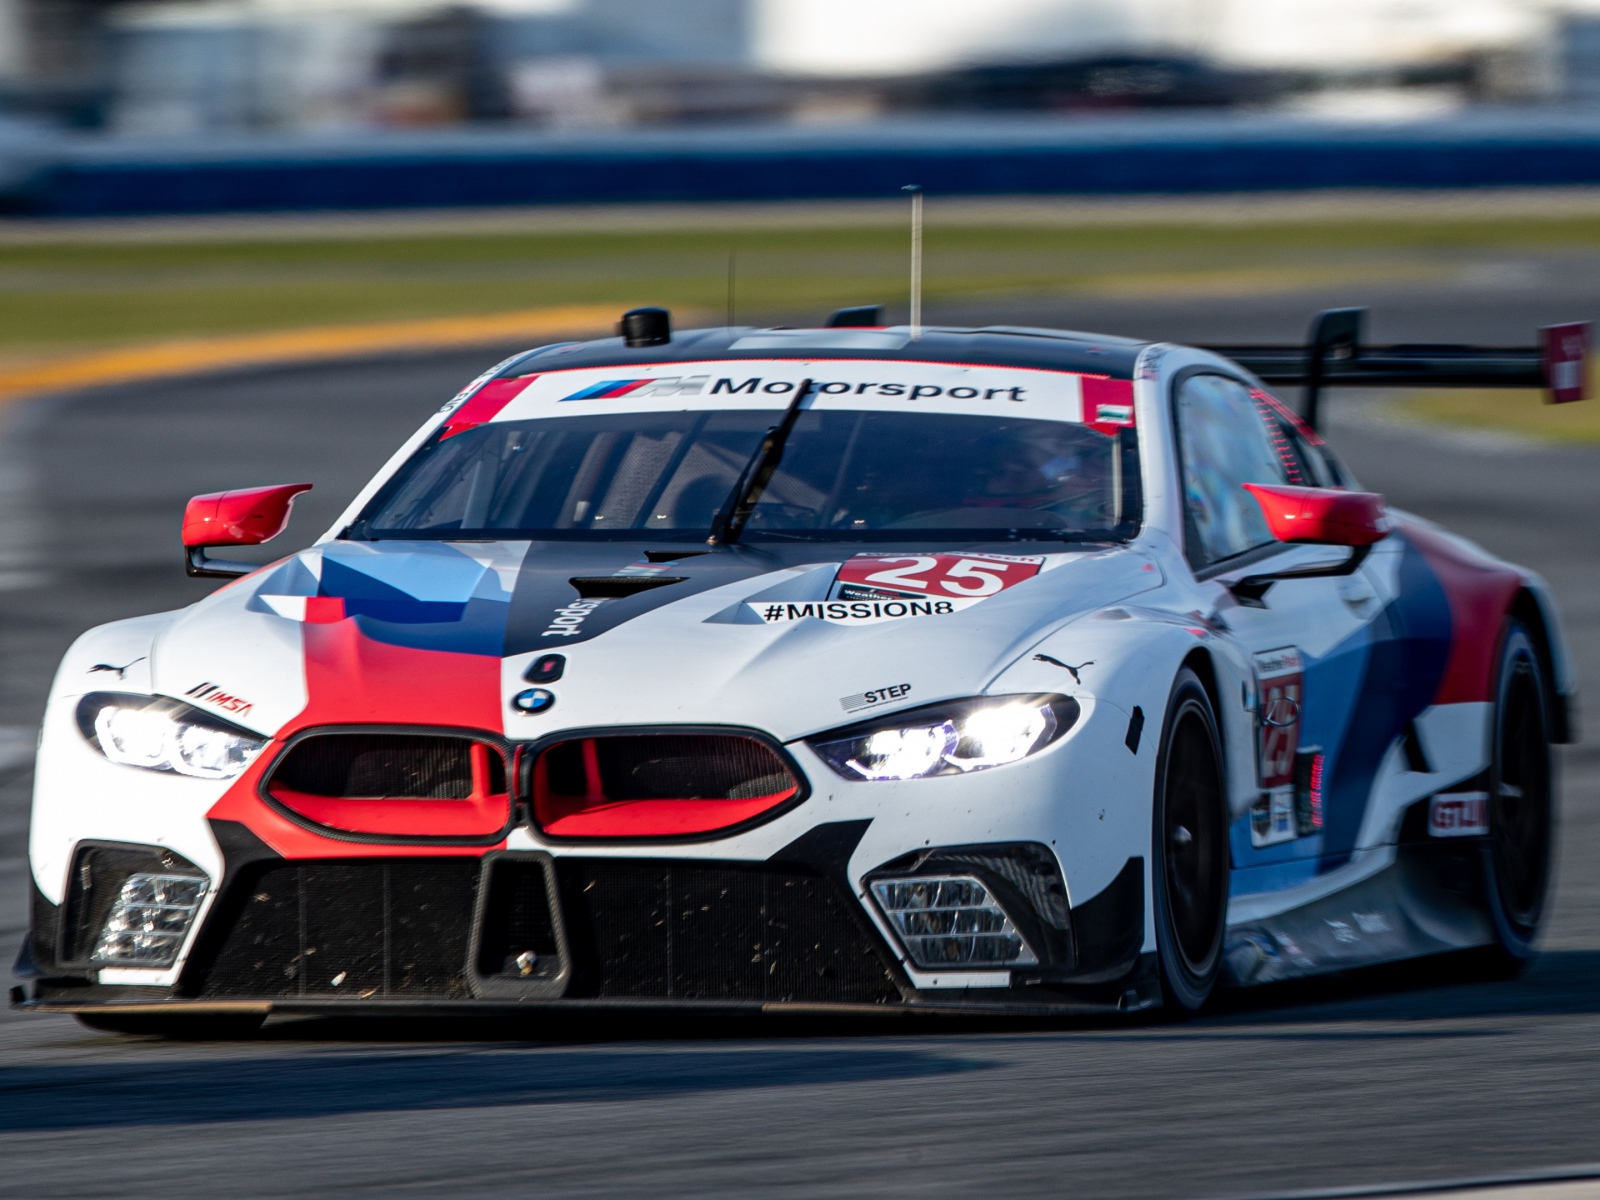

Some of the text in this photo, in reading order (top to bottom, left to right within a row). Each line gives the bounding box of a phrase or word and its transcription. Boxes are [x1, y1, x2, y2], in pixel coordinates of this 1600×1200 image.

[864, 556, 1005, 597] 25
[843, 589, 895, 601] Weather
[763, 600, 954, 621] #MISSION8
[203, 690, 255, 718] IMSA
[863, 683, 912, 704] STEP
